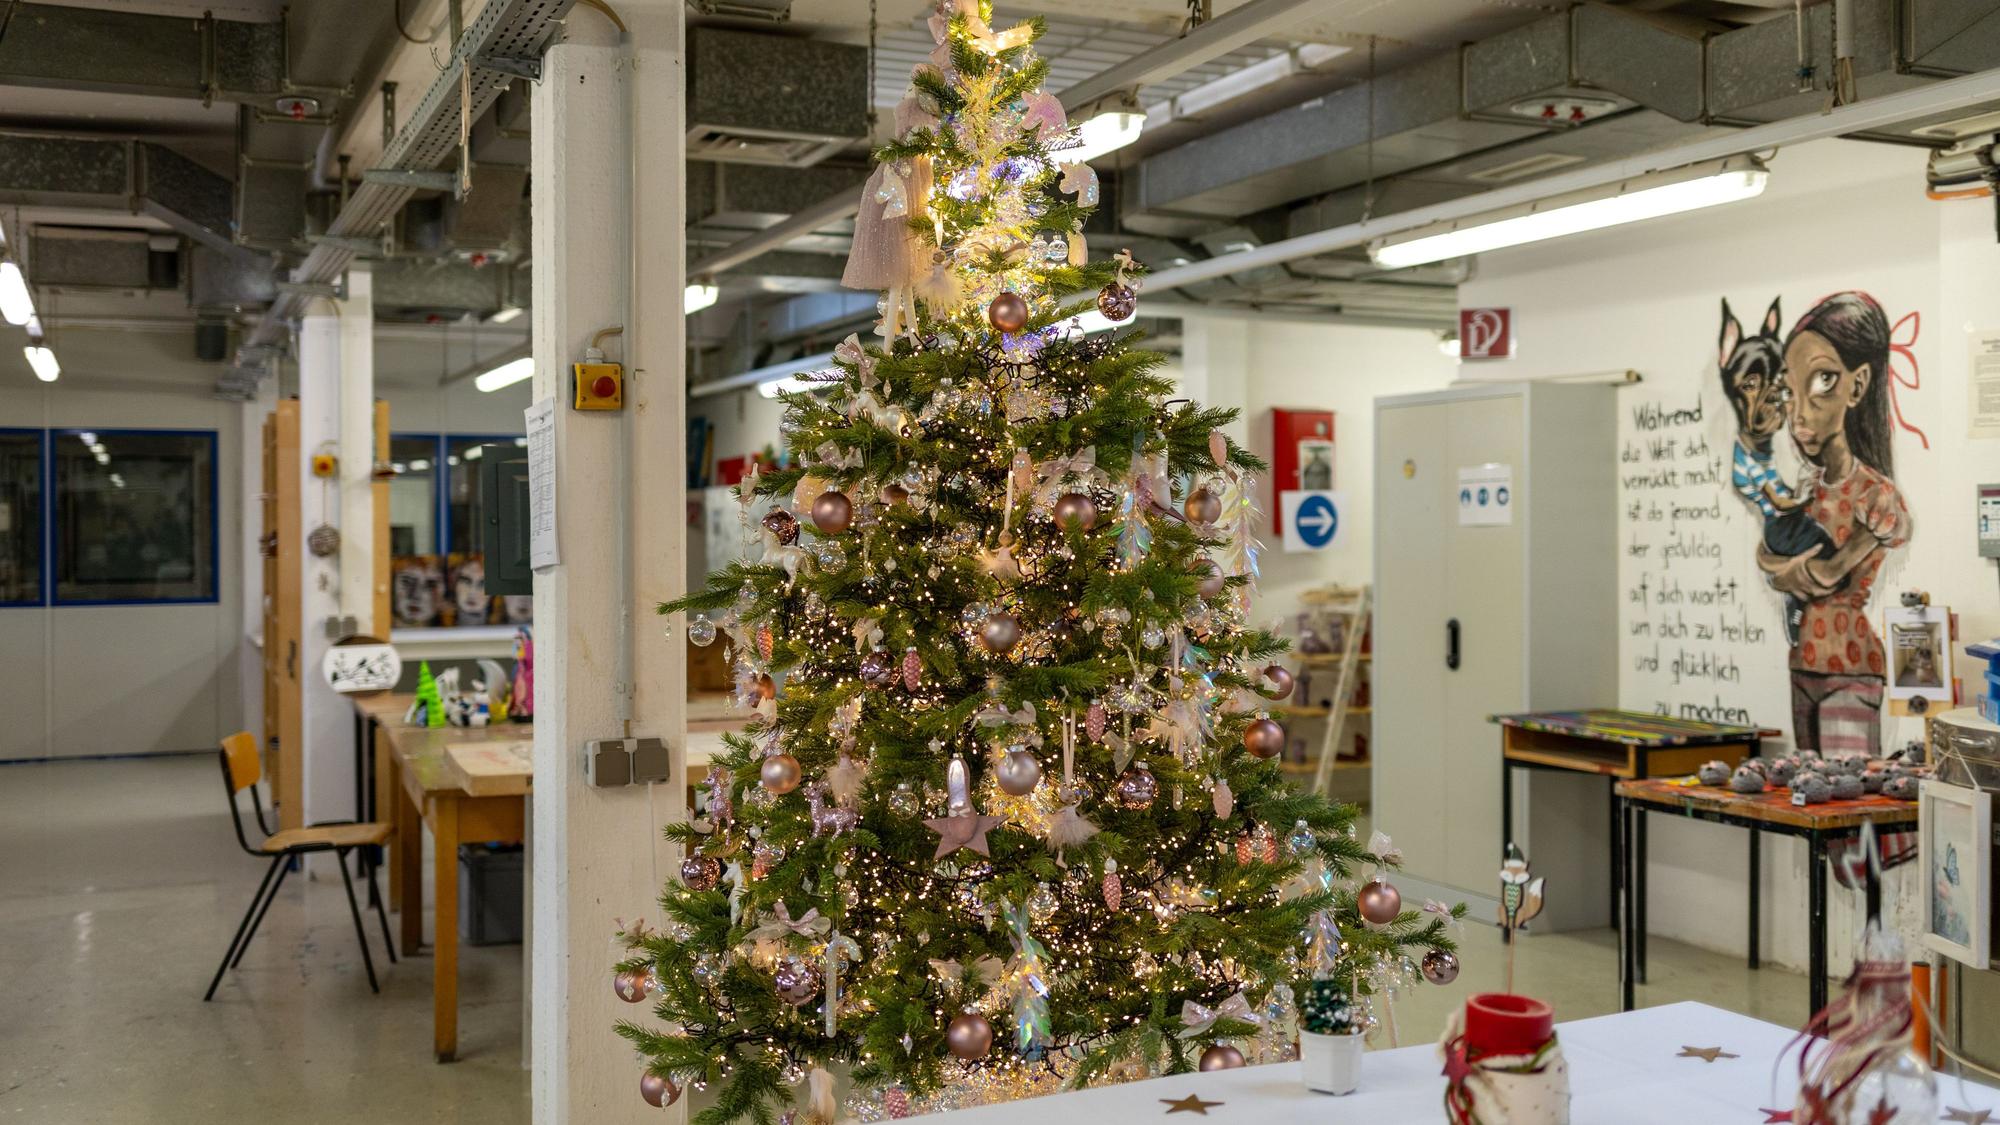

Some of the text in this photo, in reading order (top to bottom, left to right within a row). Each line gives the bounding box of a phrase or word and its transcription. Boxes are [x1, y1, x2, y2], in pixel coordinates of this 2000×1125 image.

[1632, 392, 1703, 431] Während
[1647, 437, 1678, 461] Welt
[1684, 434, 1709, 459] dich
[1623, 467, 1680, 490] verrückt
[1663, 531, 1722, 570] geduldig
[1656, 577, 1683, 604] dich
[1631, 609, 1765, 644] um dich zu heilen
[1635, 642, 1740, 685] und glücklich
[1655, 700, 1671, 716] zu
